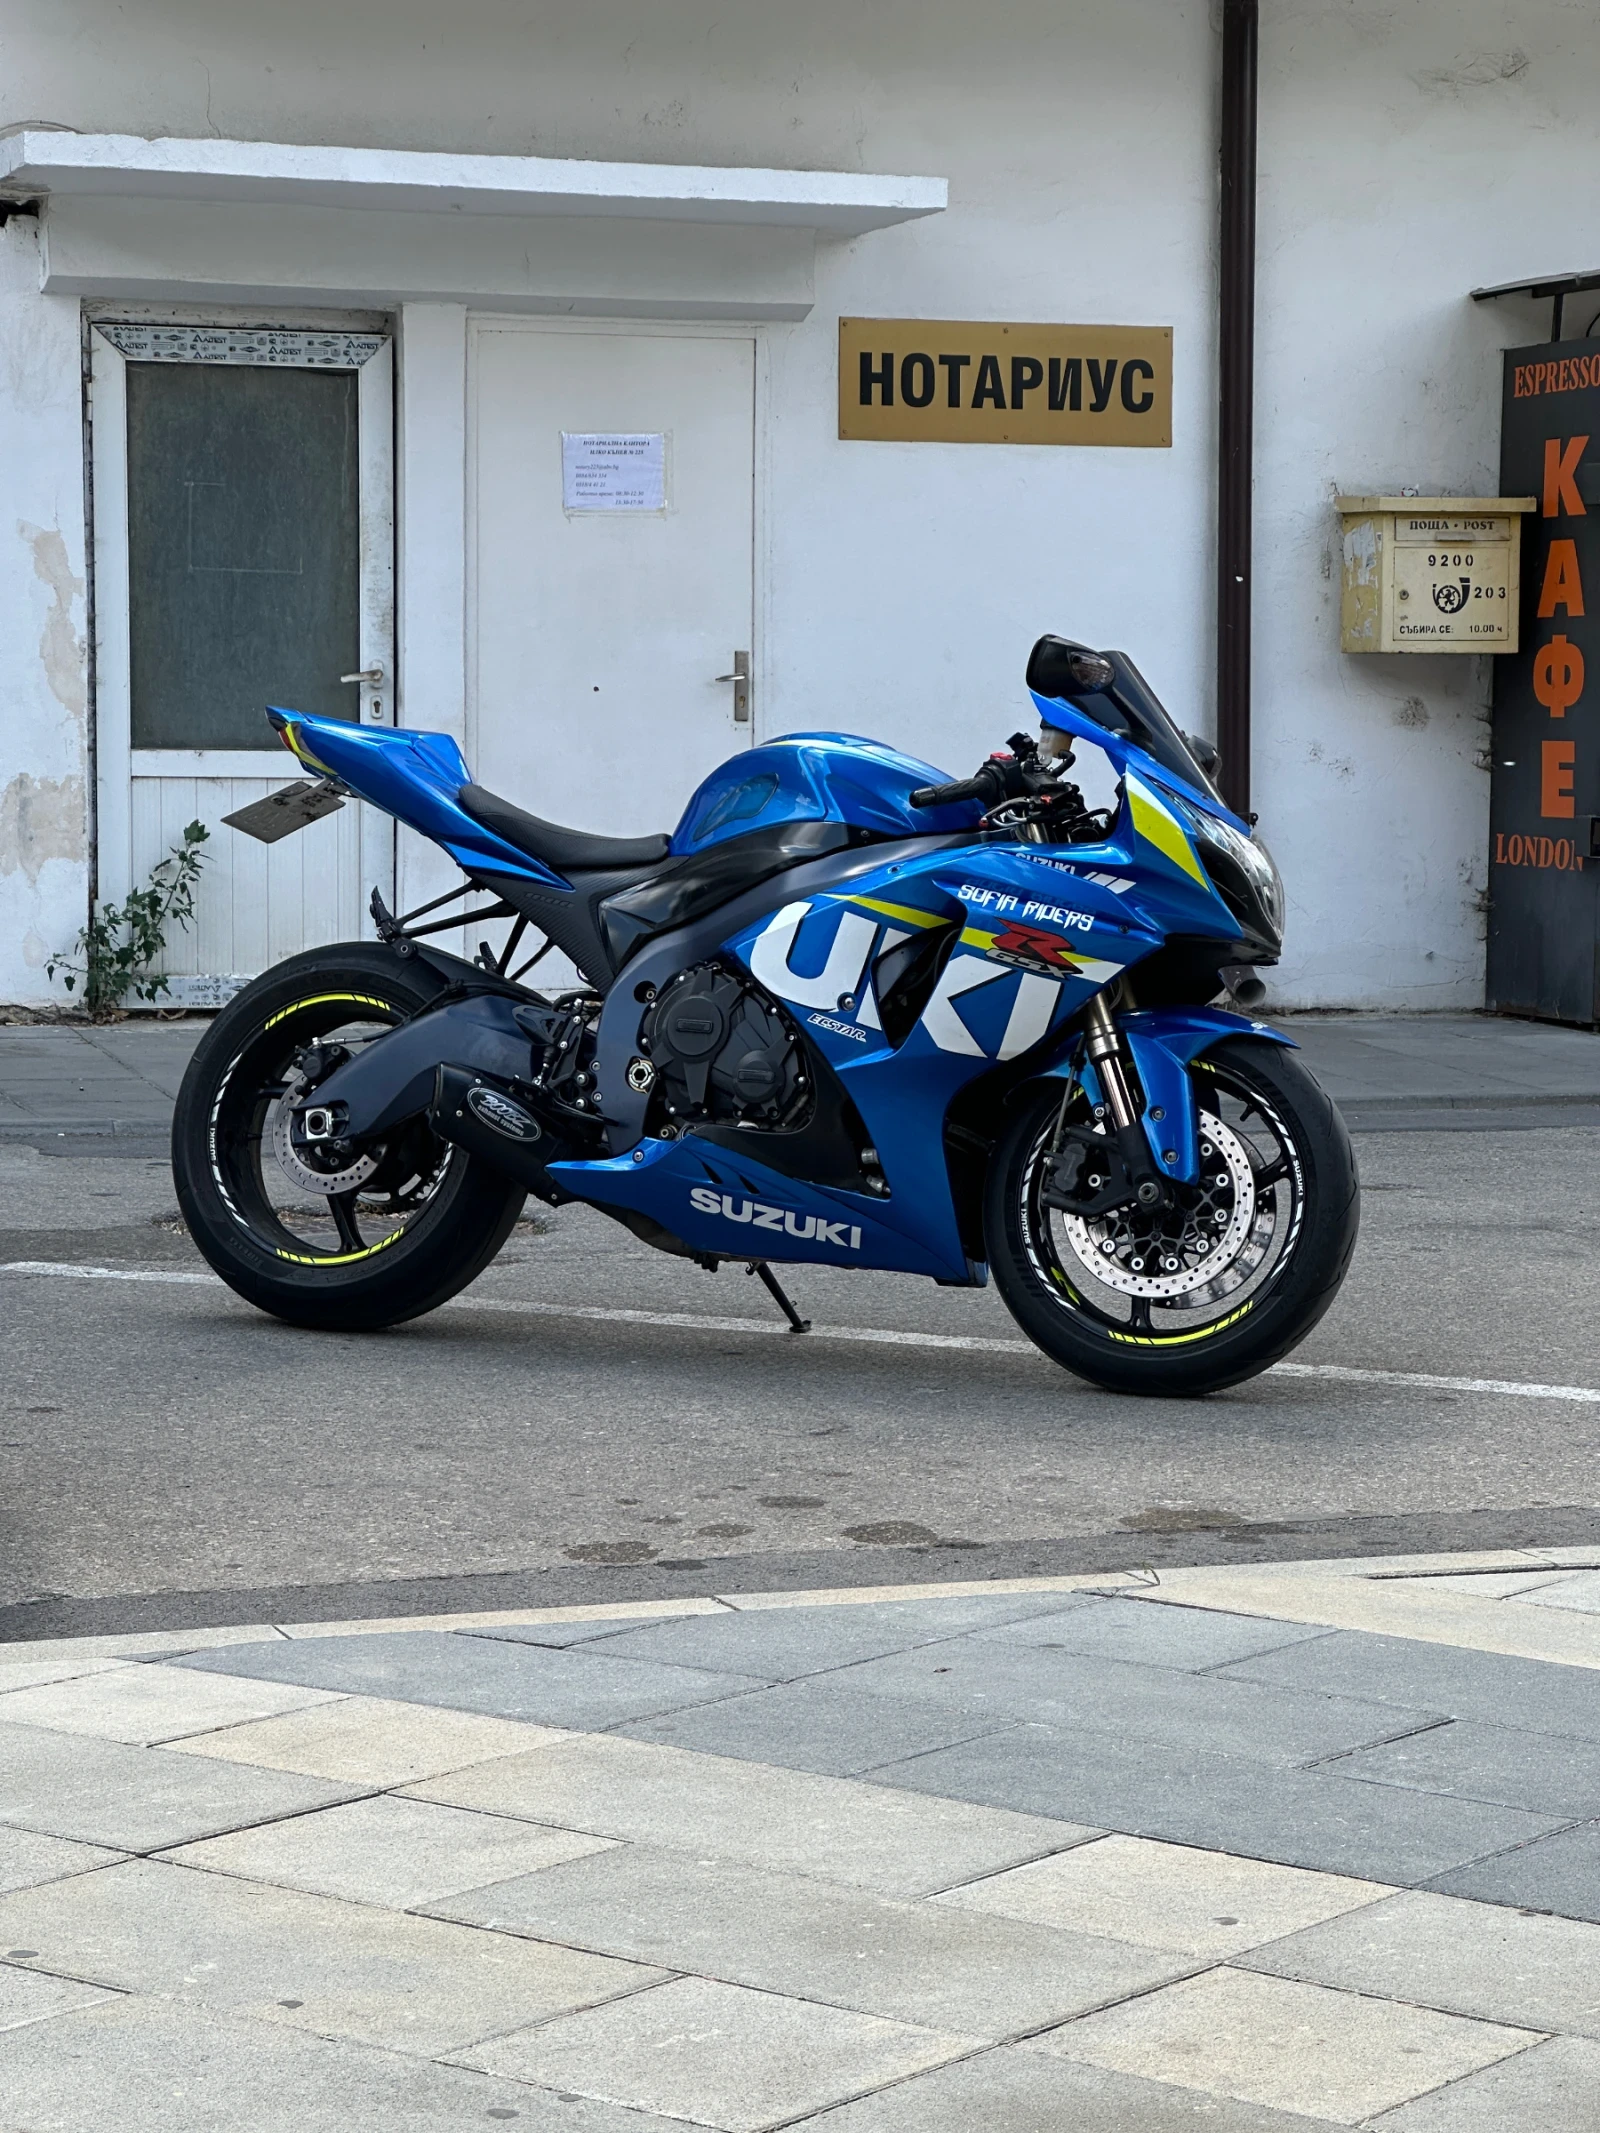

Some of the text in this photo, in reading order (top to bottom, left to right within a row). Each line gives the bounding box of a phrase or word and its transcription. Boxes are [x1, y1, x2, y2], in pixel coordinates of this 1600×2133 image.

[860, 352, 1155, 413] НОТАРИУС
[1513, 354, 1600, 398] ESPRESSO
[1409, 519, 1495, 531] ПОЩА POST
[1428, 554, 1474, 567] 9200
[1474, 587, 1506, 599] 203
[1399, 625, 1437, 635] СЪБИРА
[1469, 624, 1495, 633] 10.00
[1532, 436, 1589, 819] КАФЕ
[957, 884, 1095, 933] SOFIA RIDERS
[986, 948, 1071, 980] GSX
[807, 1013, 866, 1042] ECSTAR
[477, 1104, 525, 1137] exhaust systems
[480, 1094, 532, 1129] BOOBZ
[1293, 1159, 1304, 1196] SUZUKI
[690, 1187, 862, 1250] SUZUKI
[1020, 1208, 1031, 1245] SUZUKI
